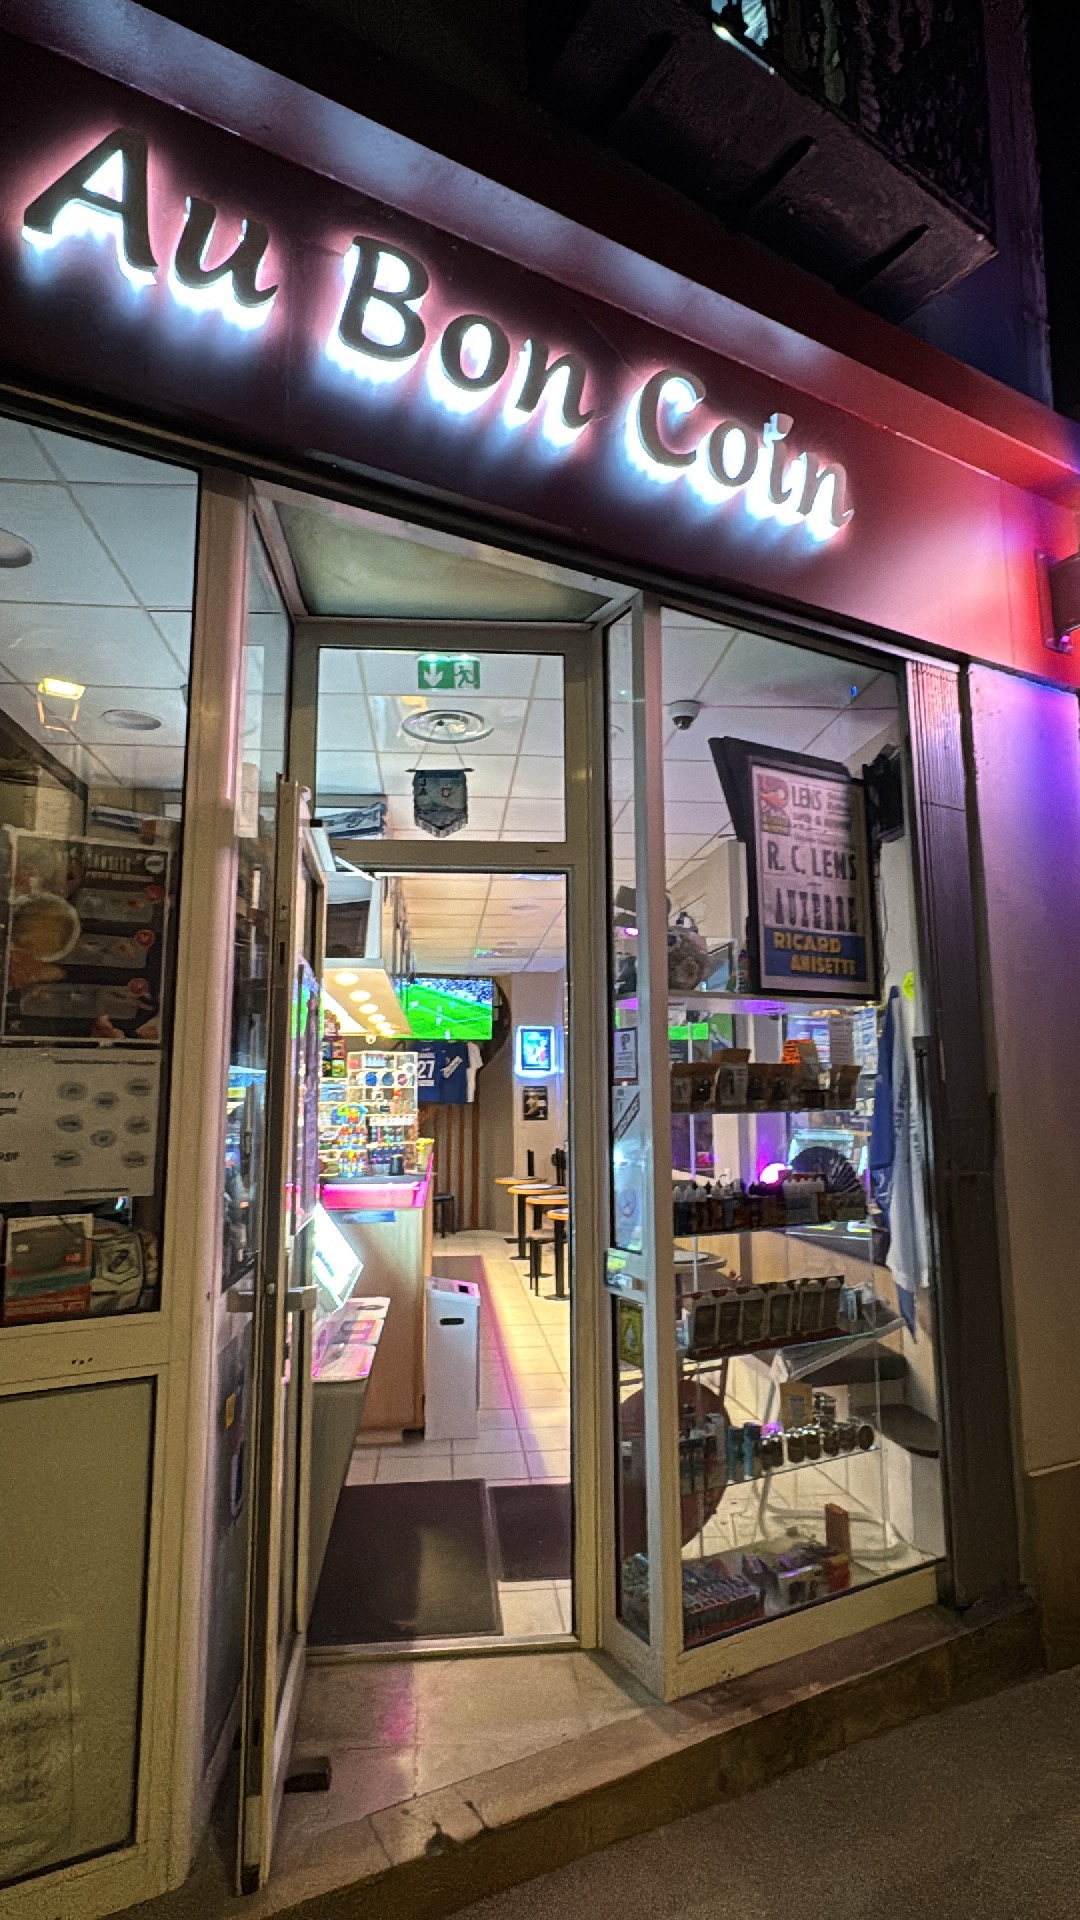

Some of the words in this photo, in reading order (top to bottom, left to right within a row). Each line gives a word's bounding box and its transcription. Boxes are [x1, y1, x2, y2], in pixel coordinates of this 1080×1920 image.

[23, 127, 278, 309] Au
[338, 235, 593, 430] Bon
[638, 368, 854, 528] Coin
[773, 931, 842, 953] RICARD
[418, 1060, 435, 1078] 27
